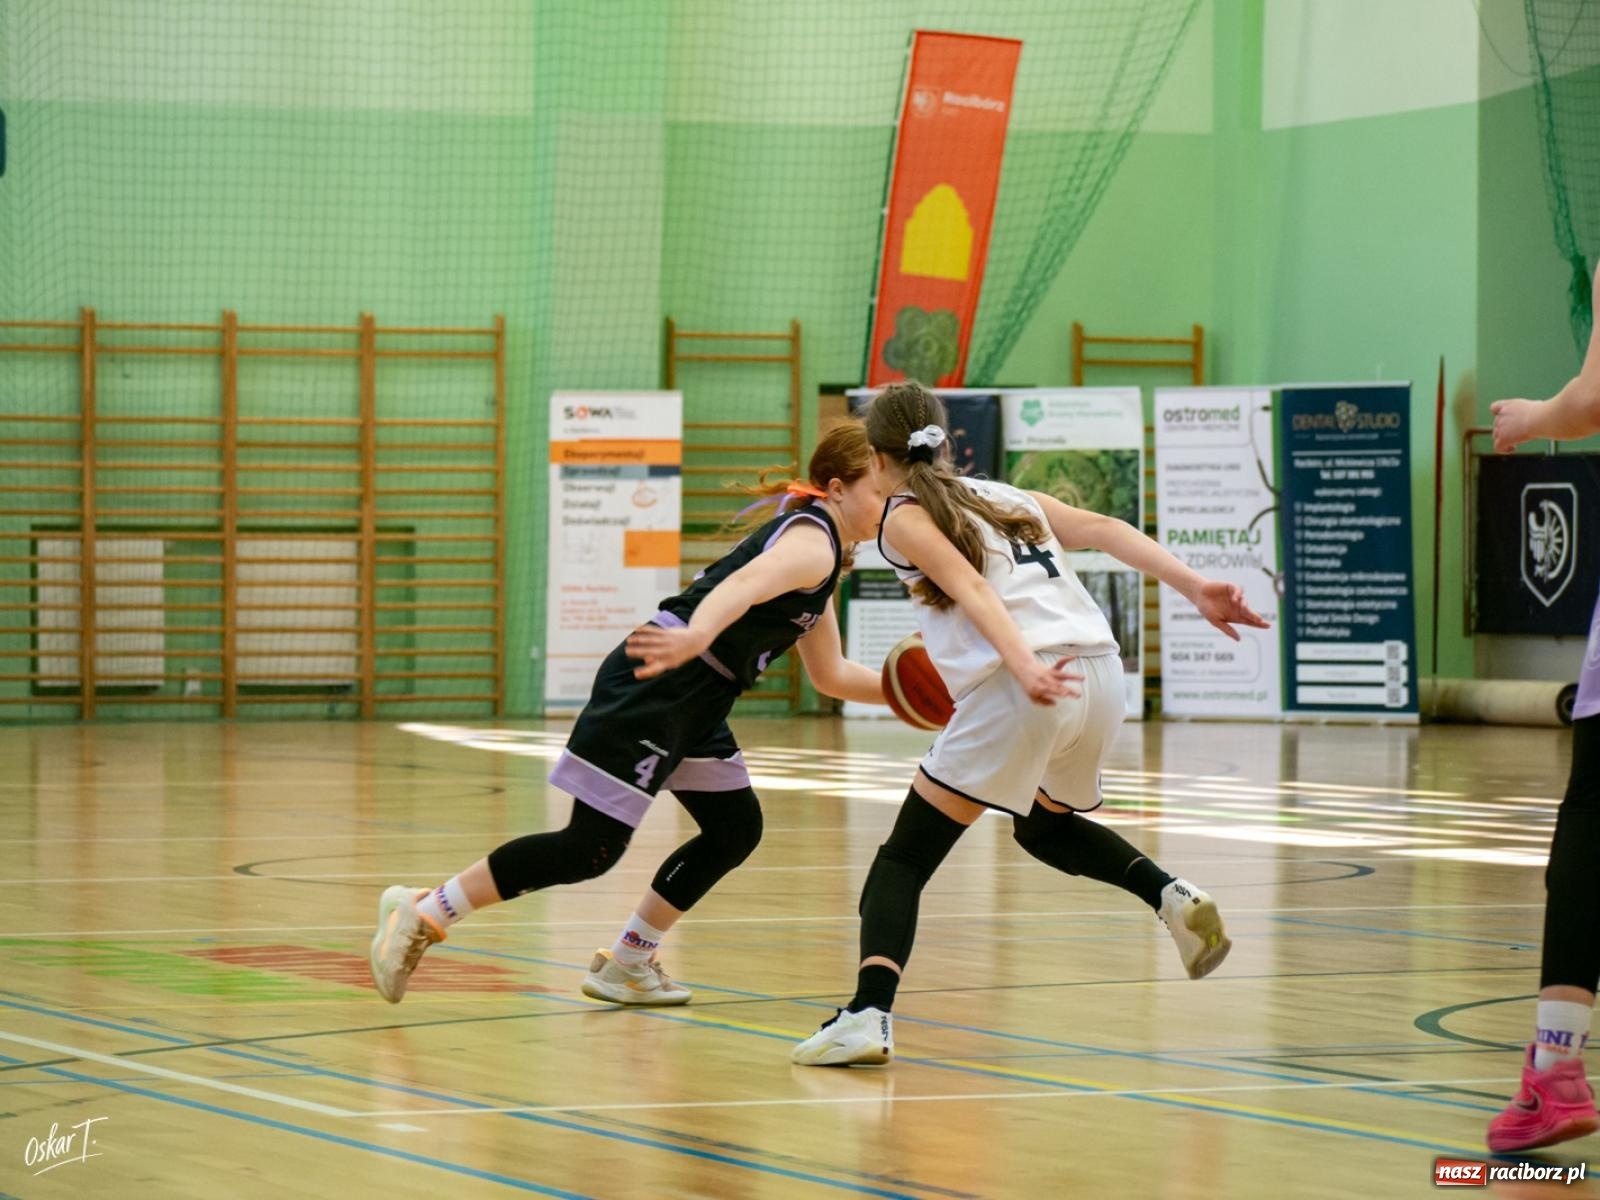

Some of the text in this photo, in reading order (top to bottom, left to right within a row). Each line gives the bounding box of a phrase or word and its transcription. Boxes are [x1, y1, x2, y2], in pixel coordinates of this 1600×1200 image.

[564, 405, 613, 420] SOWA
[1164, 404, 1240, 423] ostromed
[1167, 529, 1262, 549] PAMIĘTAJ
[1009, 540, 1060, 579] 4
[634, 754, 660, 789] 4
